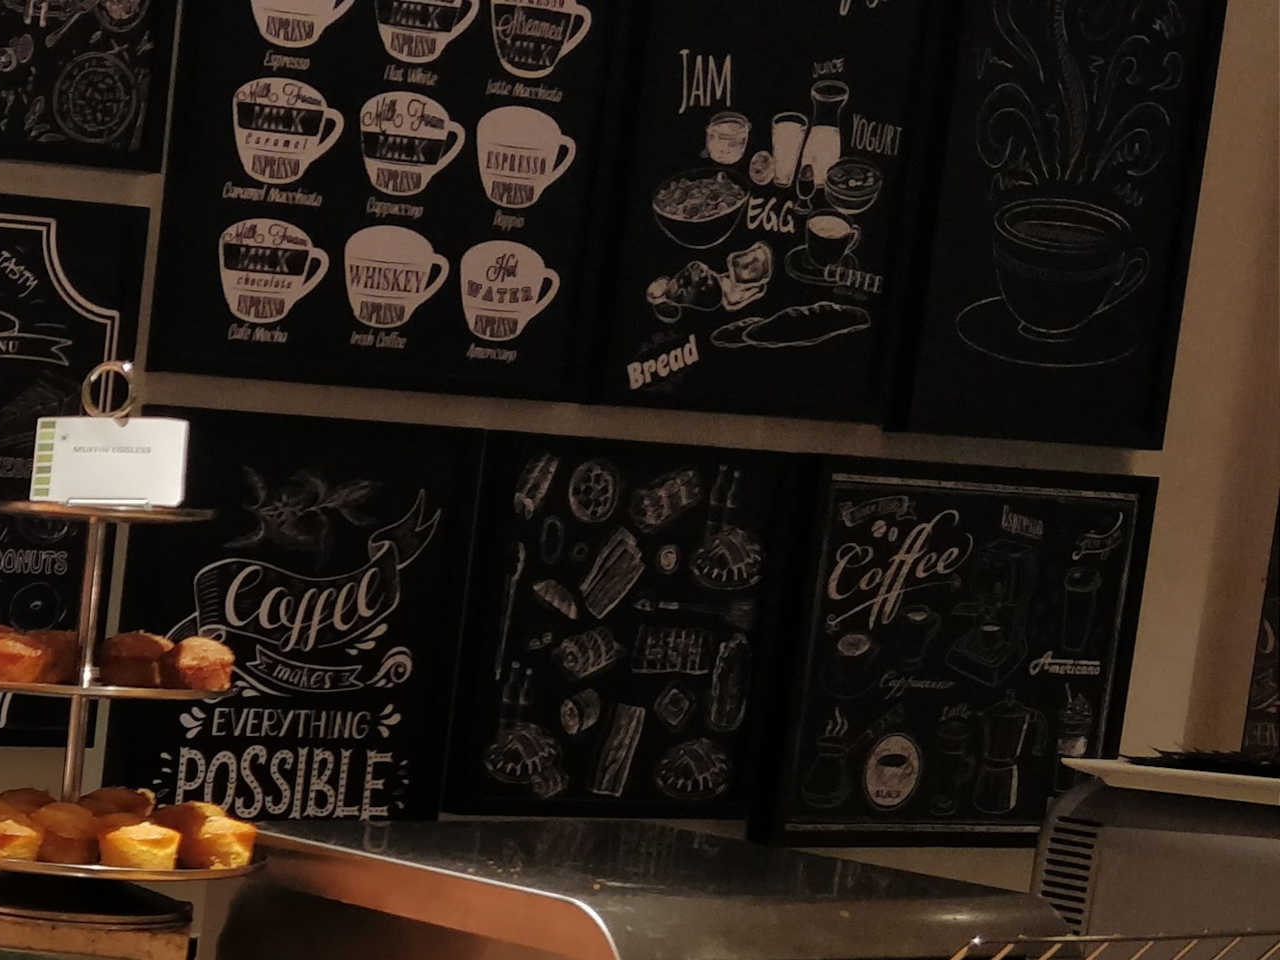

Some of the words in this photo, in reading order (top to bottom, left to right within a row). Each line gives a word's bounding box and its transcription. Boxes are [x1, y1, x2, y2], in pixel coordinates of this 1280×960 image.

[678, 48, 732, 114] JAM
[812, 58, 845, 78] JUICE
[245, 132, 308, 151] Caramel
[850, 113, 903, 156] YOGURT
[486, 150, 546, 175] ESPRESSO
[746, 197, 797, 235] EGG
[349, 264, 428, 294] WHISKEY
[485, 253, 520, 283] Hot
[824, 263, 883, 295] COFFEE
[467, 279, 534, 304] WATER
[625, 333, 701, 392] Bread
[827, 509, 974, 631] Coffee
[224, 563, 381, 653] Coffee
[272, 655, 334, 690] makes
[210, 706, 372, 739] EVERYTHING
[174, 743, 395, 821] POSSIBLE
